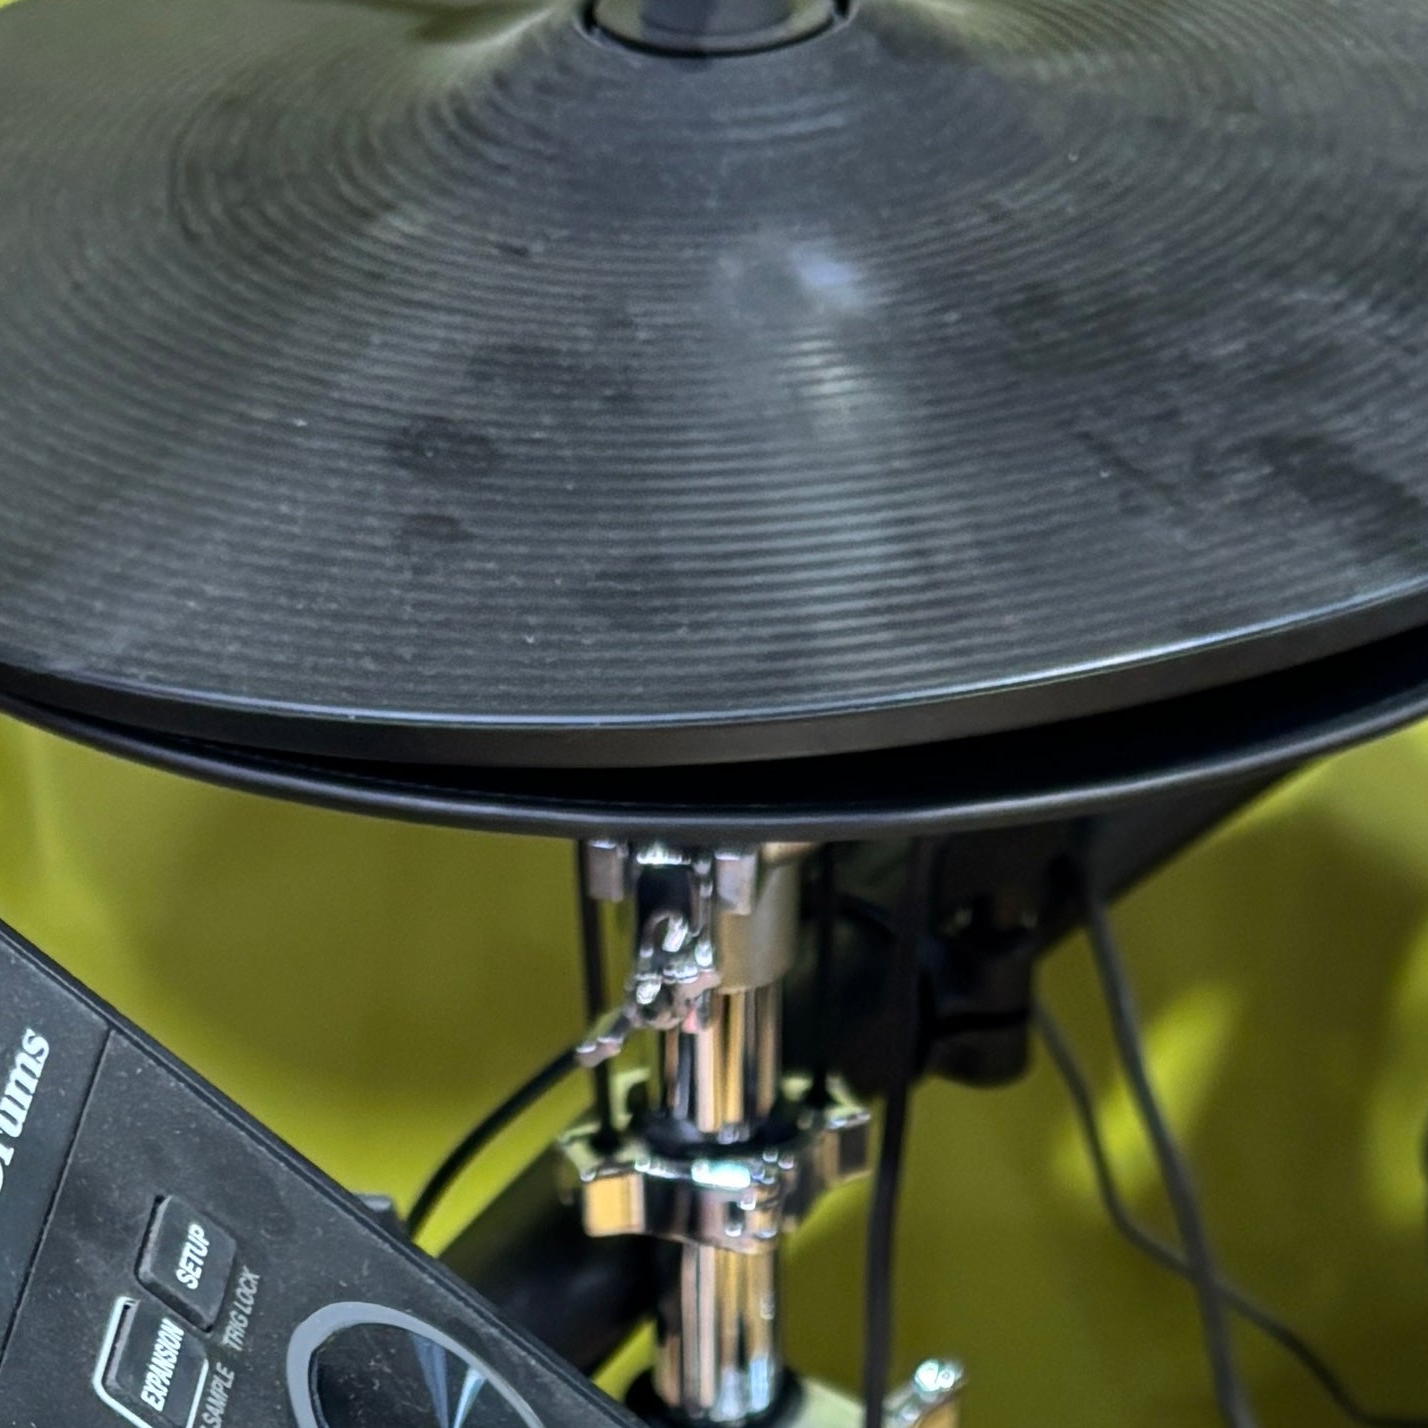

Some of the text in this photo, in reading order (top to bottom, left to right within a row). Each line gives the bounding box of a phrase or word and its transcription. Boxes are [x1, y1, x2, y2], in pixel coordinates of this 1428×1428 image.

[175, 1223, 211, 1290] SETUP
[222, 1265, 261, 1351] TRIG LOCK
[140, 1317, 185, 1412] EXPANSION
